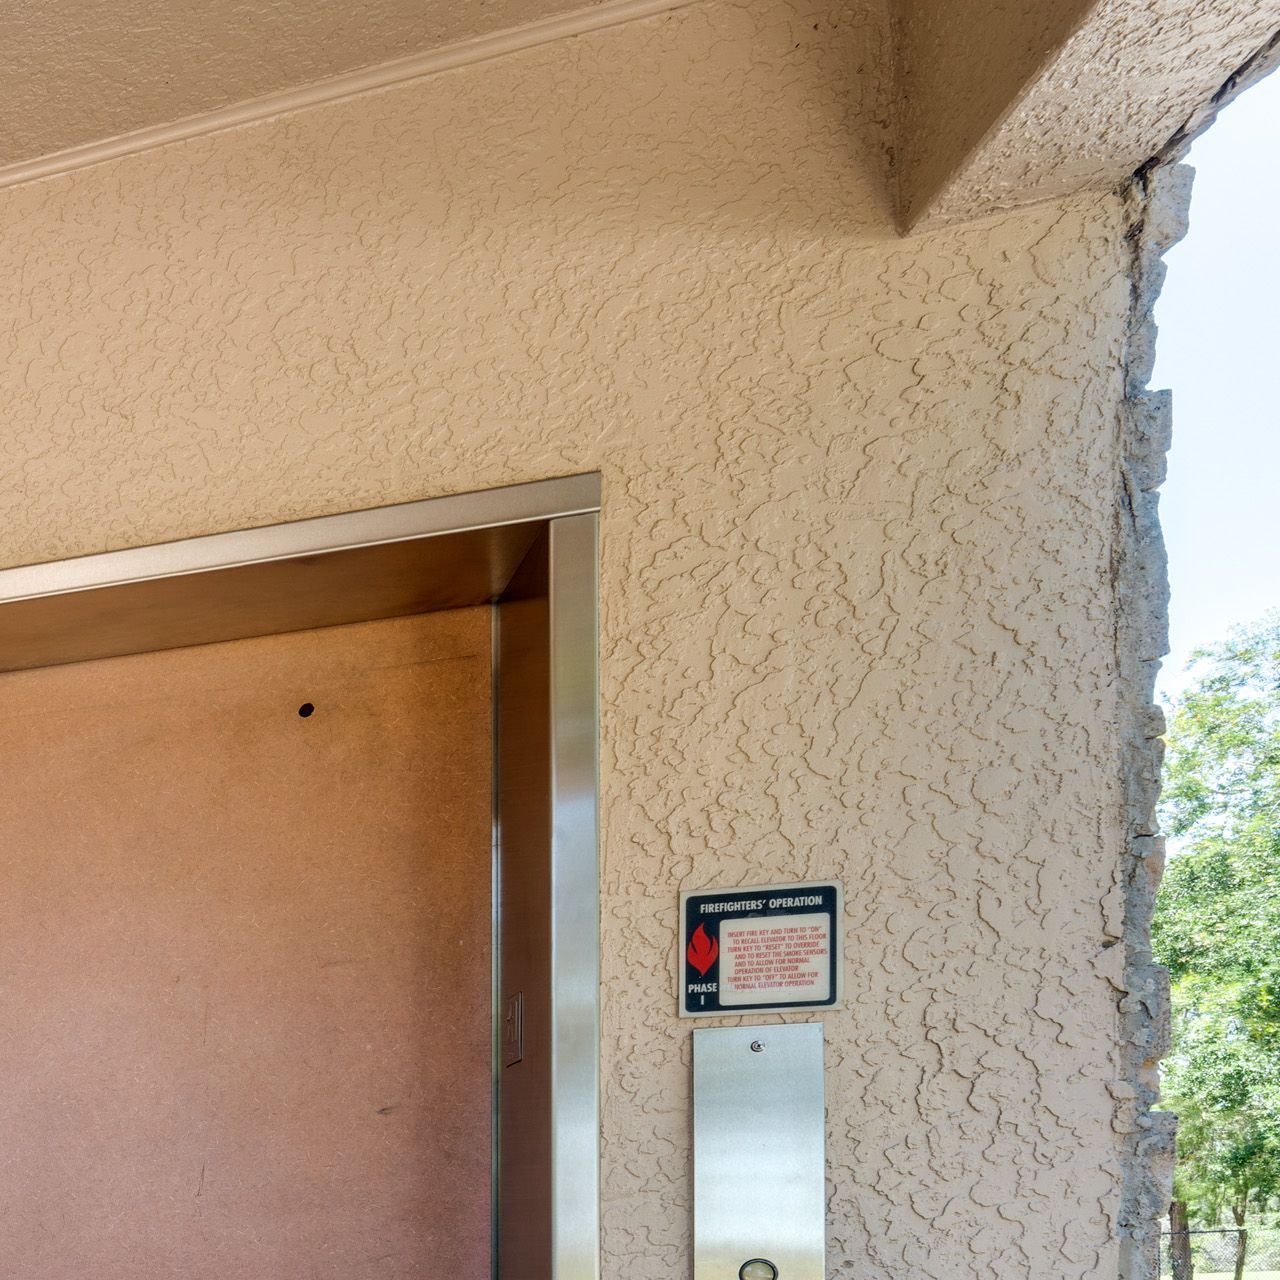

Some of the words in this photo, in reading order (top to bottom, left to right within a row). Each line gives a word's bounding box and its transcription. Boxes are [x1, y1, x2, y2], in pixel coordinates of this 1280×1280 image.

[700, 900, 766, 913] FIREFIGHTERS'
[769, 896, 822, 908] OPERATION
[688, 983, 717, 993] PHASE
